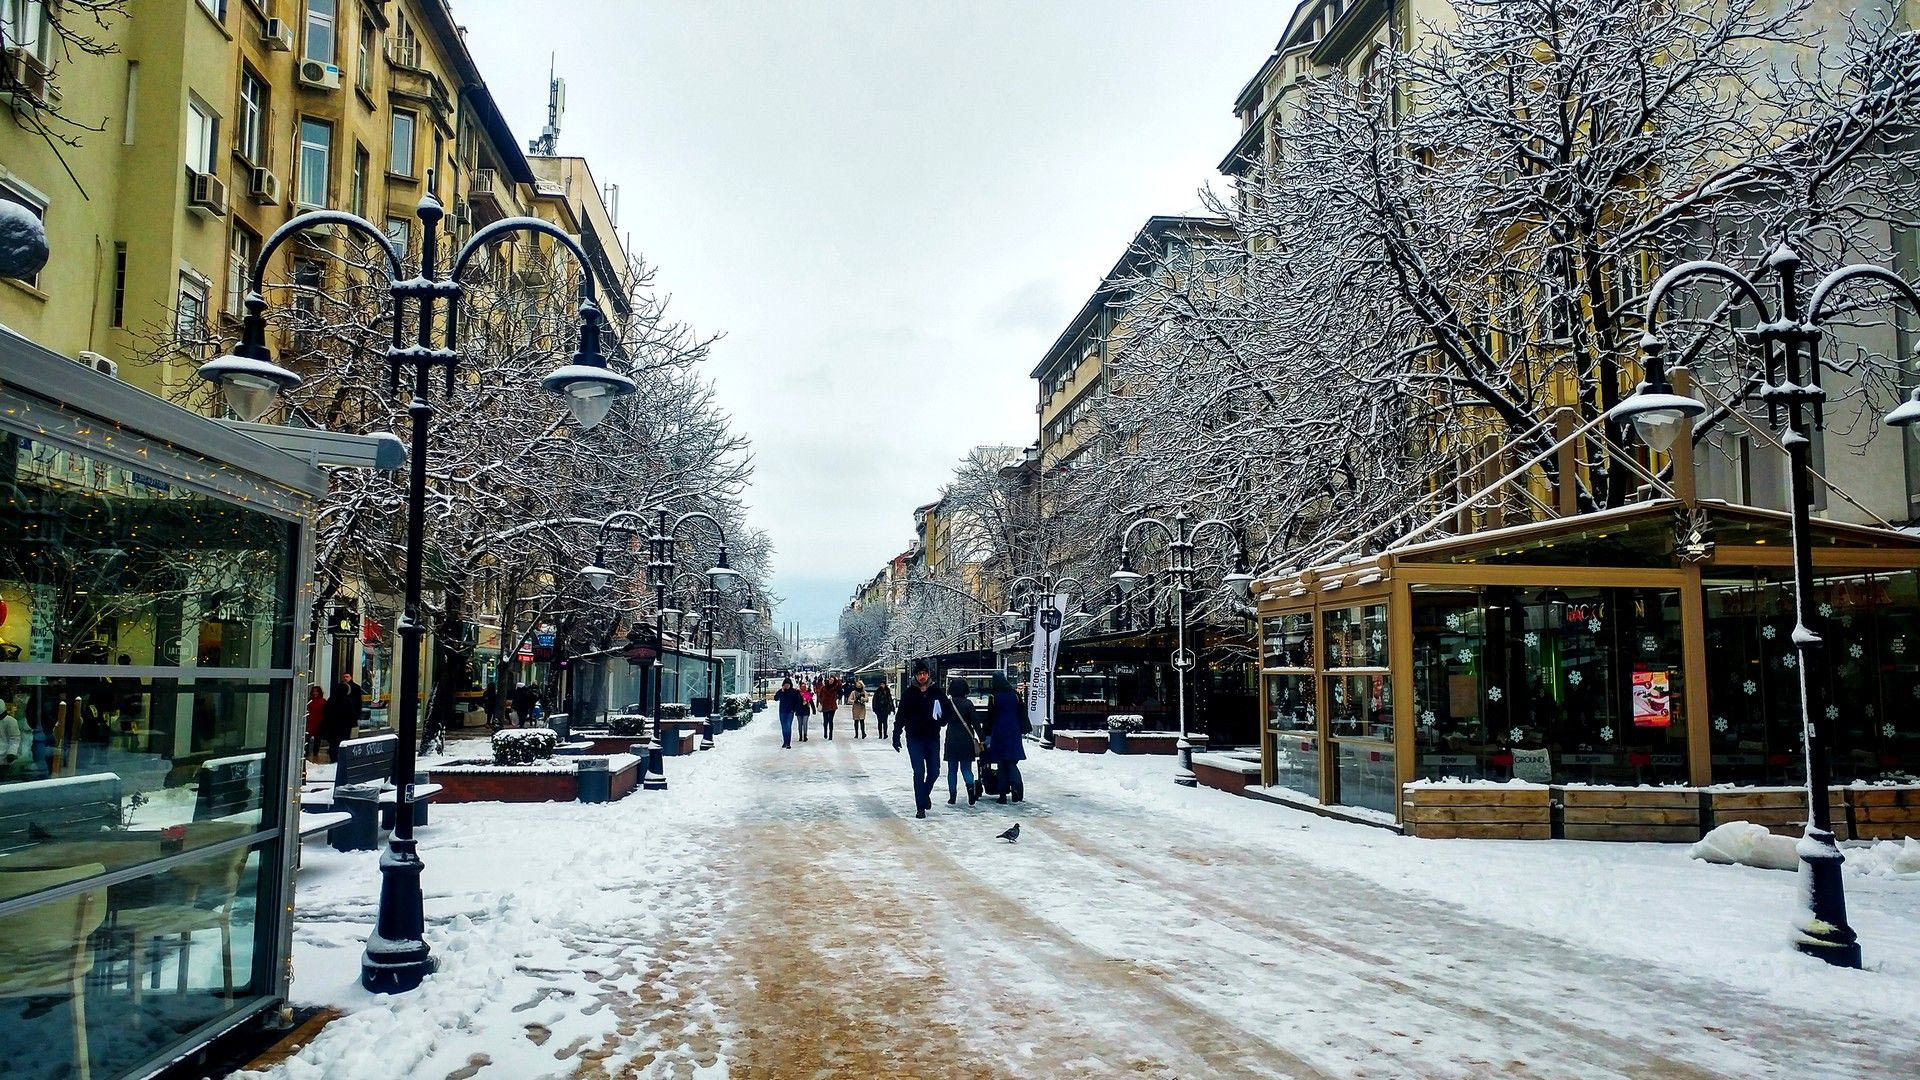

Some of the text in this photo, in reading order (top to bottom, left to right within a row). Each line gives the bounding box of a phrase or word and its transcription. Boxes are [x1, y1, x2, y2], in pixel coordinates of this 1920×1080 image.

[1030, 666, 1041, 712] GOOD FOOD
[1514, 756, 1545, 764] GROUND
